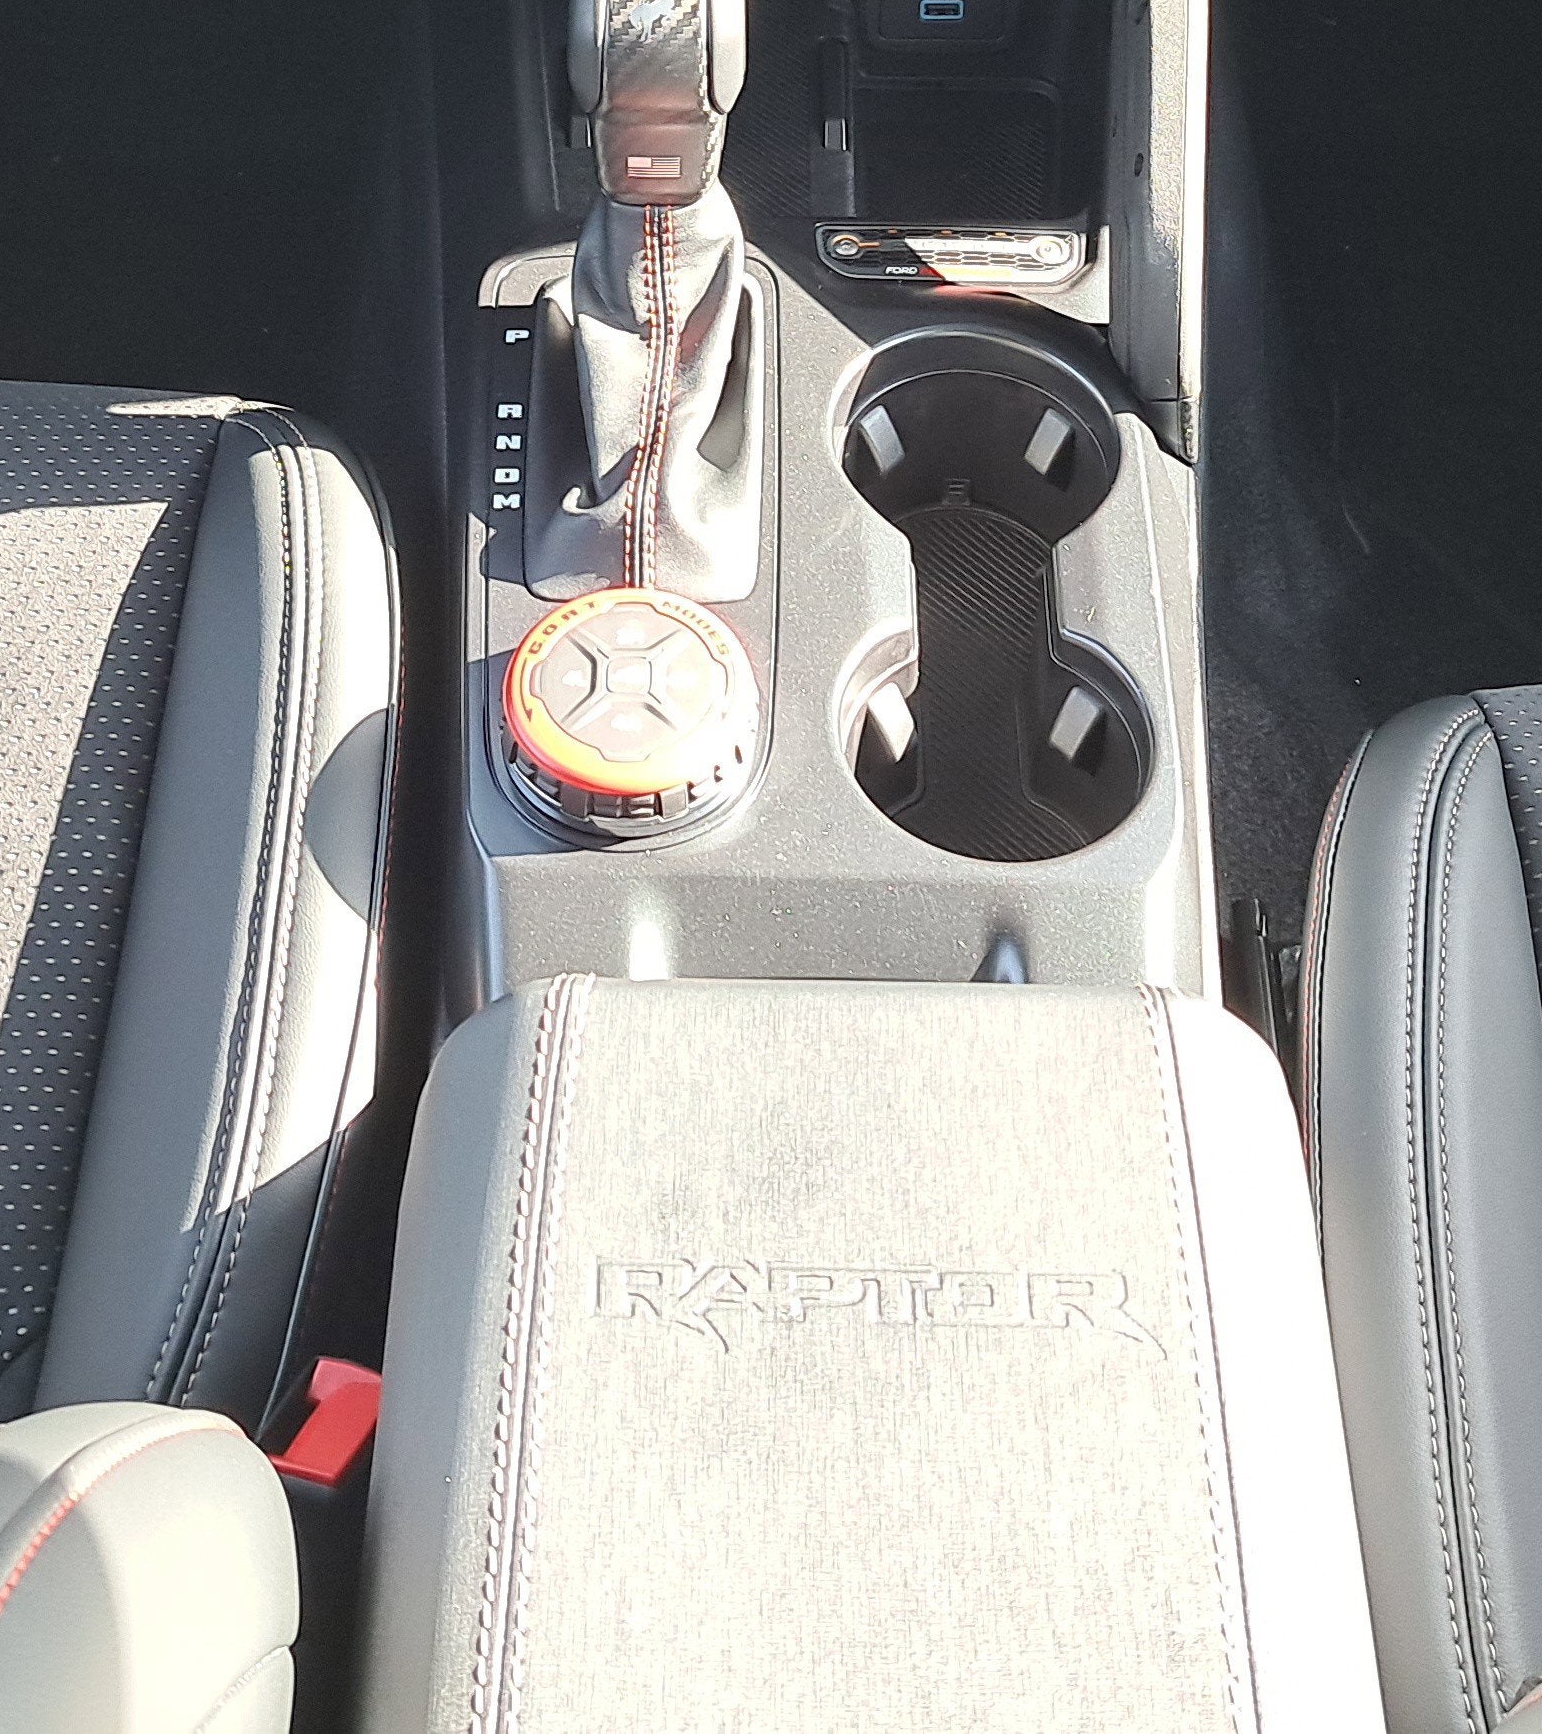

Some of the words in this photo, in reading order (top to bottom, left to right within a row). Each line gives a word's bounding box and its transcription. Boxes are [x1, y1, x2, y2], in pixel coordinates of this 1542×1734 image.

[884, 266, 918, 276] FORD
[504, 329, 530, 344] P
[497, 403, 523, 418] R
[495, 434, 522, 450] N
[493, 468, 520, 483] D
[492, 493, 521, 509] M
[585, 1256, 1169, 1356] RAPTOR
